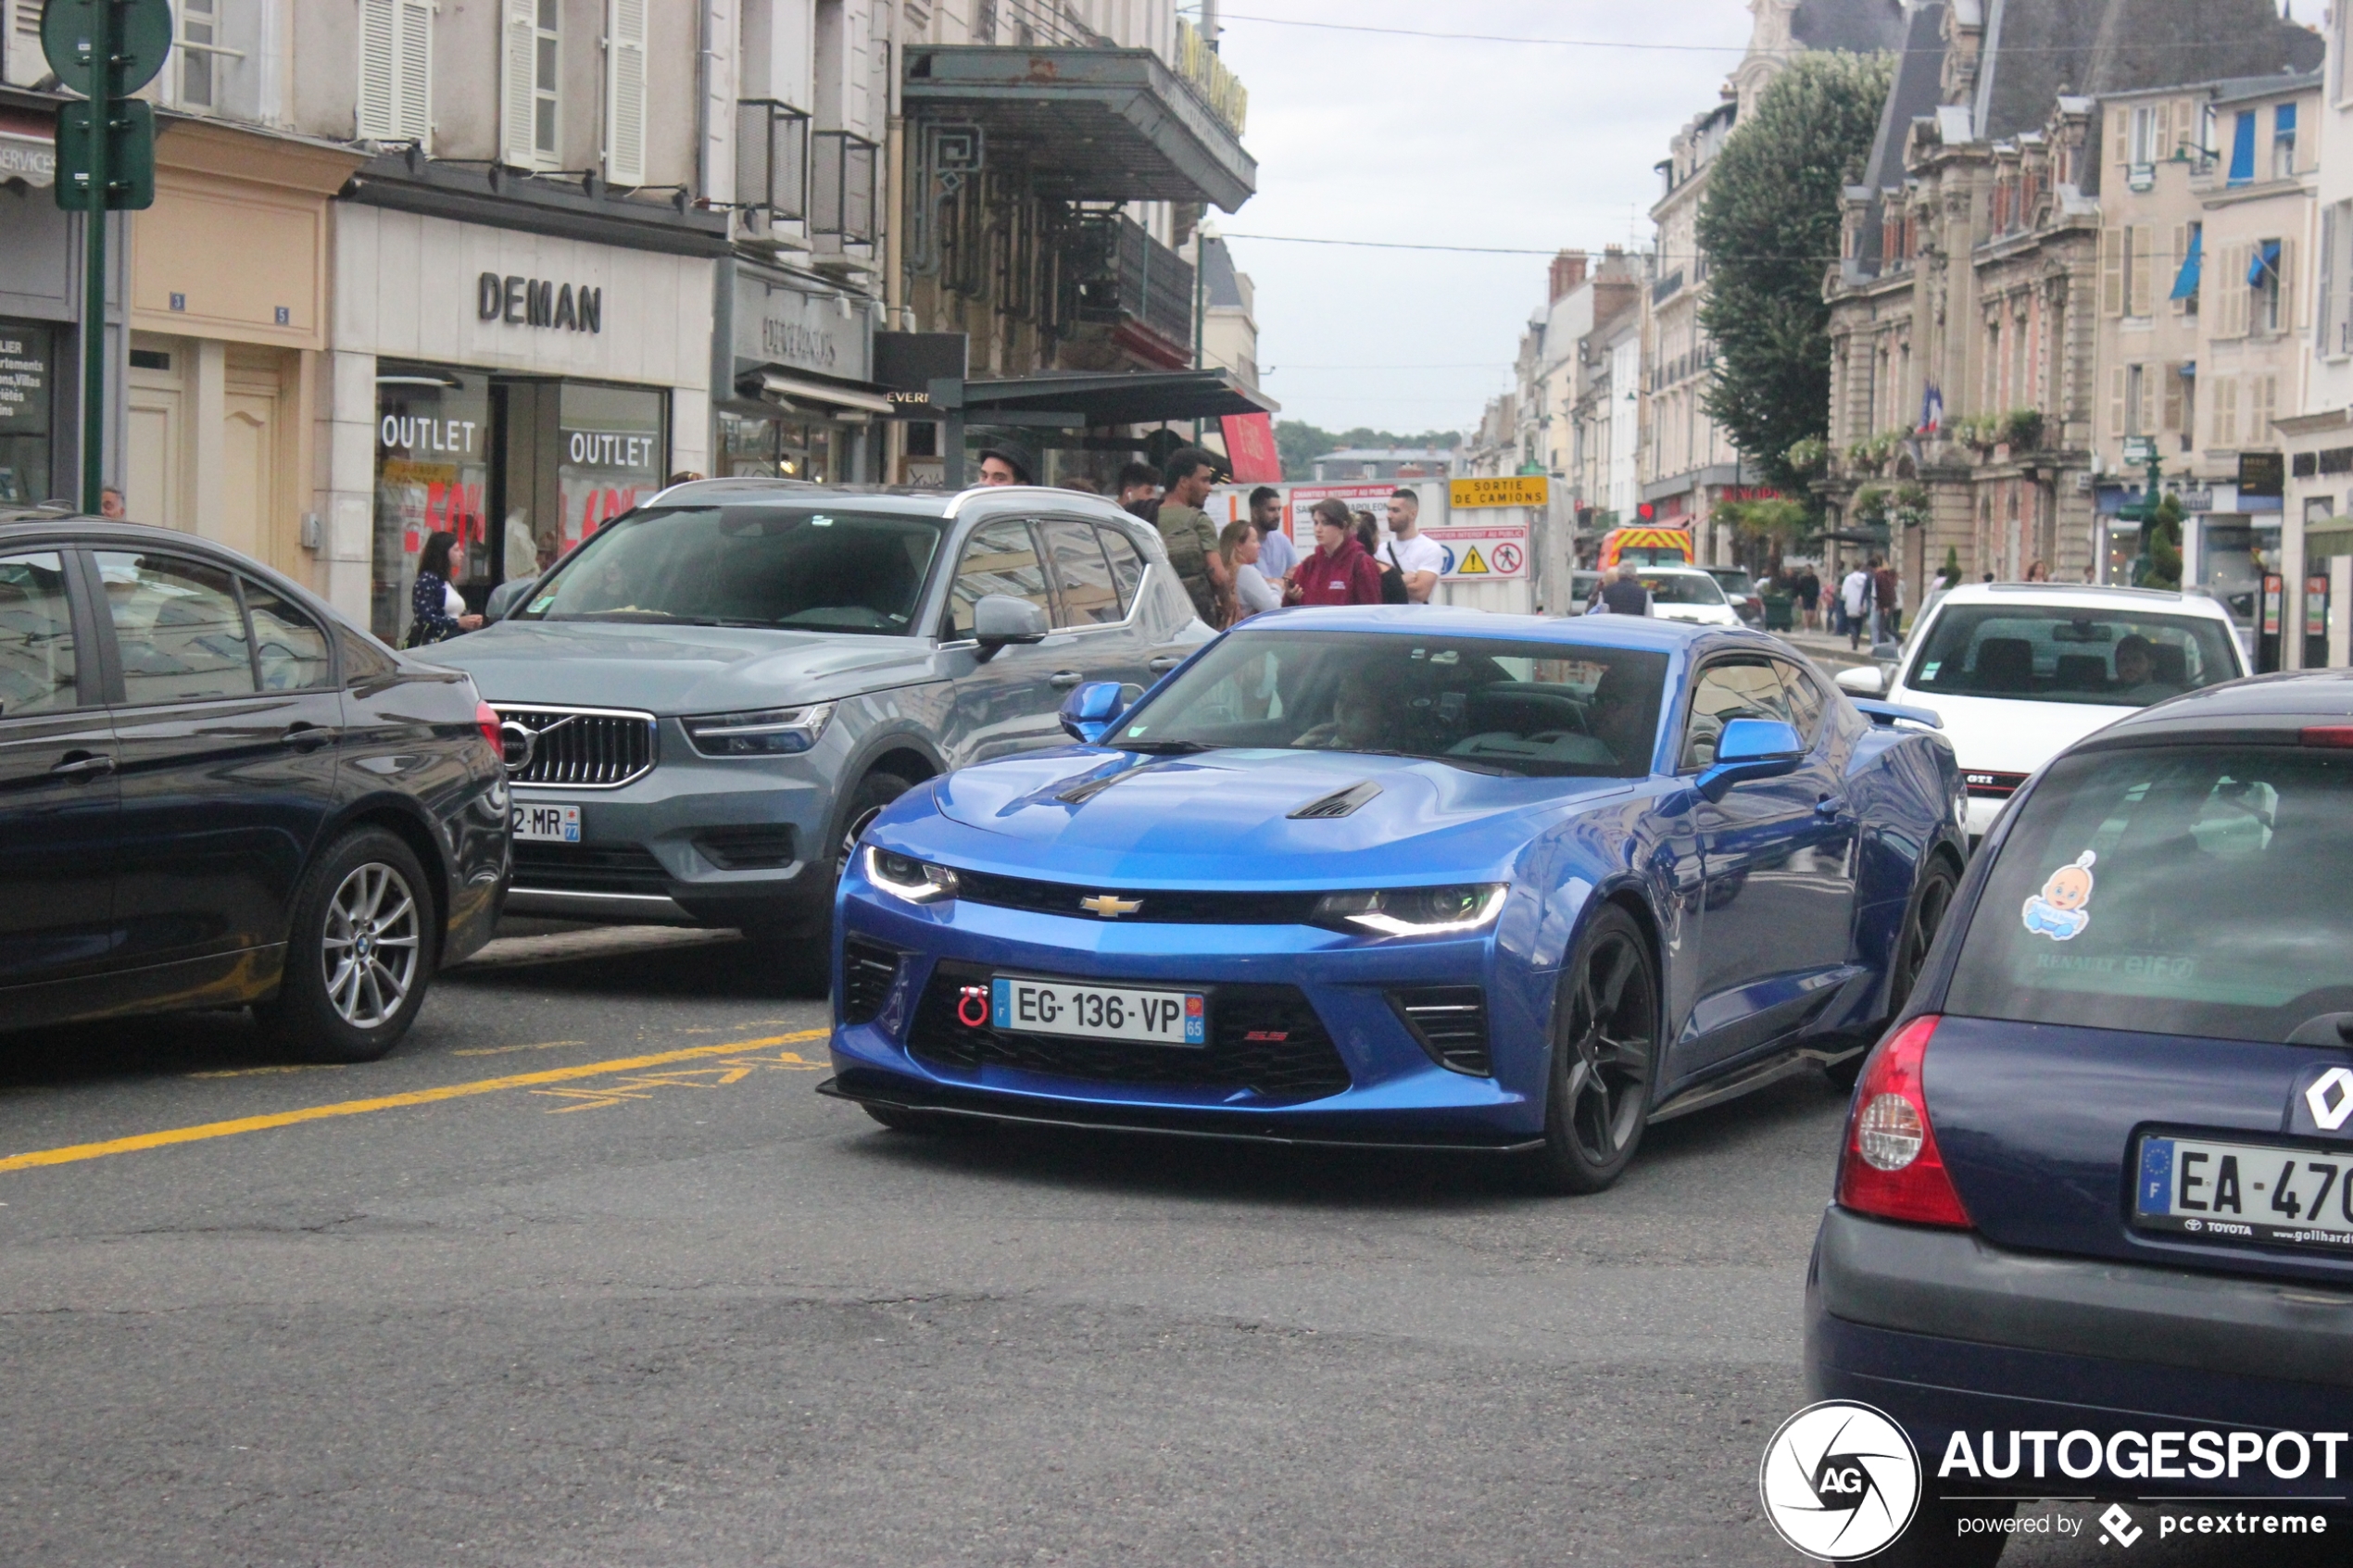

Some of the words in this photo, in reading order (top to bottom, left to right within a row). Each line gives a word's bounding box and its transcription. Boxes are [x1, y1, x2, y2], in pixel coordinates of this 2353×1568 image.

[0, 148, 56, 175] ERVICES
[174, 295, 181, 308] 3
[478, 271, 601, 333] DEMAN
[279, 308, 285, 322] 5
[0, 388, 24, 401] iétés
[382, 414, 476, 453] OUTLET
[570, 433, 653, 468] OUTLET
[1293, 490, 1327, 499] CHANTIER
[1327, 489, 1357, 498] INTERDIT
[1358, 488, 1368, 496] AU
[1369, 487, 1395, 496] PUBLIC
[1474, 481, 1523, 492] SORTIE
[1454, 495, 1471, 504] DE
[1479, 492, 1542, 504] CAMIONS
[1427, 531, 1456, 540] HANTIER
[1457, 530, 1486, 539] INTERDIT
[1487, 530, 1497, 538] AU
[1498, 529, 1522, 538] PUBLIC
[1967, 774, 1994, 784] GTI
[566, 824, 579, 838] 77
[2037, 953, 2117, 972] RENAULT
[2125, 955, 2169, 977] elf
[998, 1008, 1005, 1018] F
[1187, 1021, 1202, 1036] 65
[2149, 1182, 2160, 1198] F
[2207, 1222, 2253, 1236] TOYOTA
